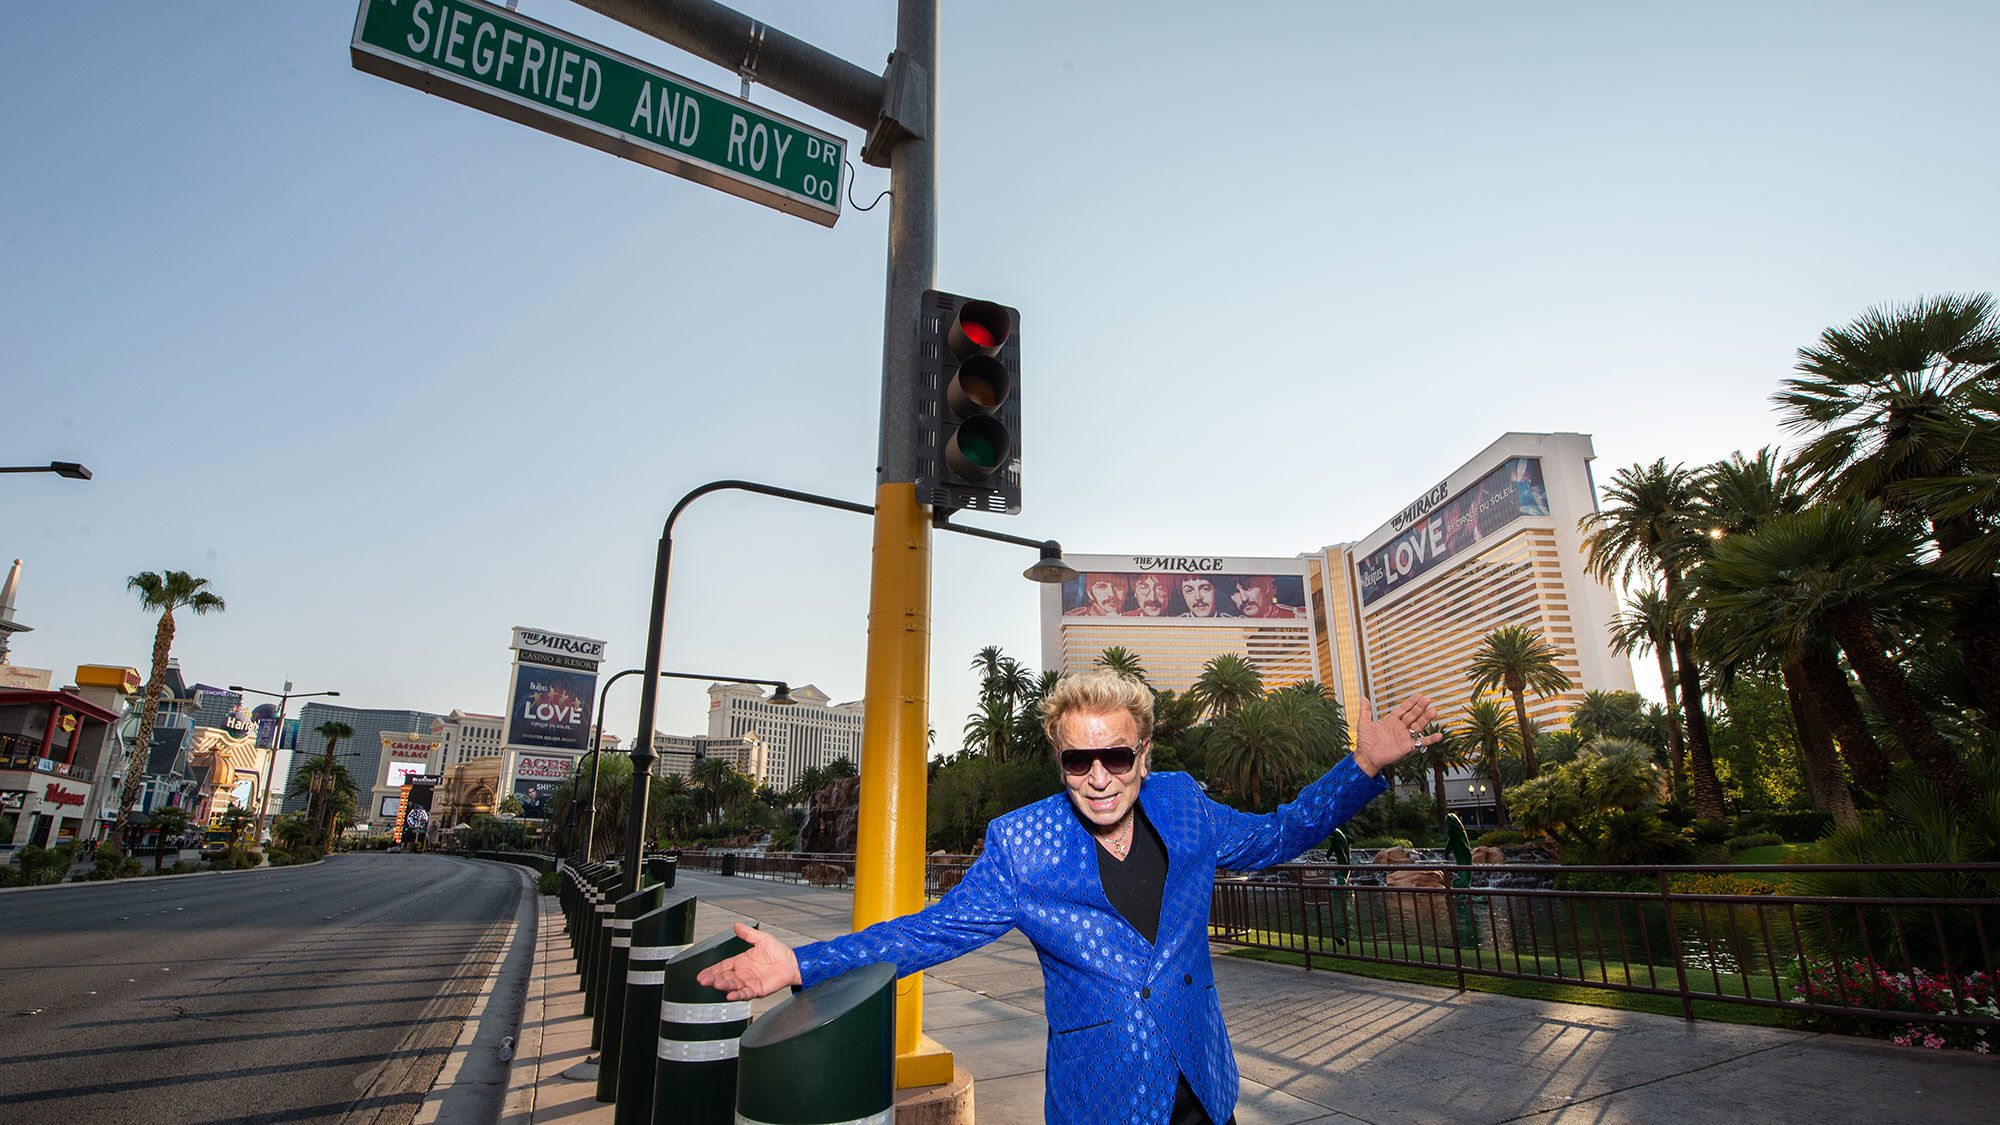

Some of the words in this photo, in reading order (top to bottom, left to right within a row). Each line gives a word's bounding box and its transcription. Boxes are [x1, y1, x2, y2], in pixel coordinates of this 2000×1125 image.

[406, 0, 602, 111] SIEGFRIED
[628, 80, 701, 148] AND
[726, 114, 793, 180] ROY
[806, 136, 837, 167] DR
[1394, 481, 1448, 532] MIRAGE
[1383, 517, 1447, 585] LOVE
[1455, 508, 1479, 528] CIRQUE
[1479, 500, 1490, 513] DU
[1490, 485, 1515, 506] SOLEIL
[1133, 557, 1152, 565] THE
[1140, 557, 1223, 572] MIRAGE
[521, 631, 540, 641] THE
[525, 634, 601, 656] MIRAGE
[520, 651, 554, 664] CASINO
[564, 658, 597, 670] RESORT
[524, 701, 583, 725] LOVE
[391, 742, 431, 751] CAESARS
[391, 750, 428, 759] PALACE
[520, 758, 570, 770] ACES
[517, 768, 569, 778] COMEDY
